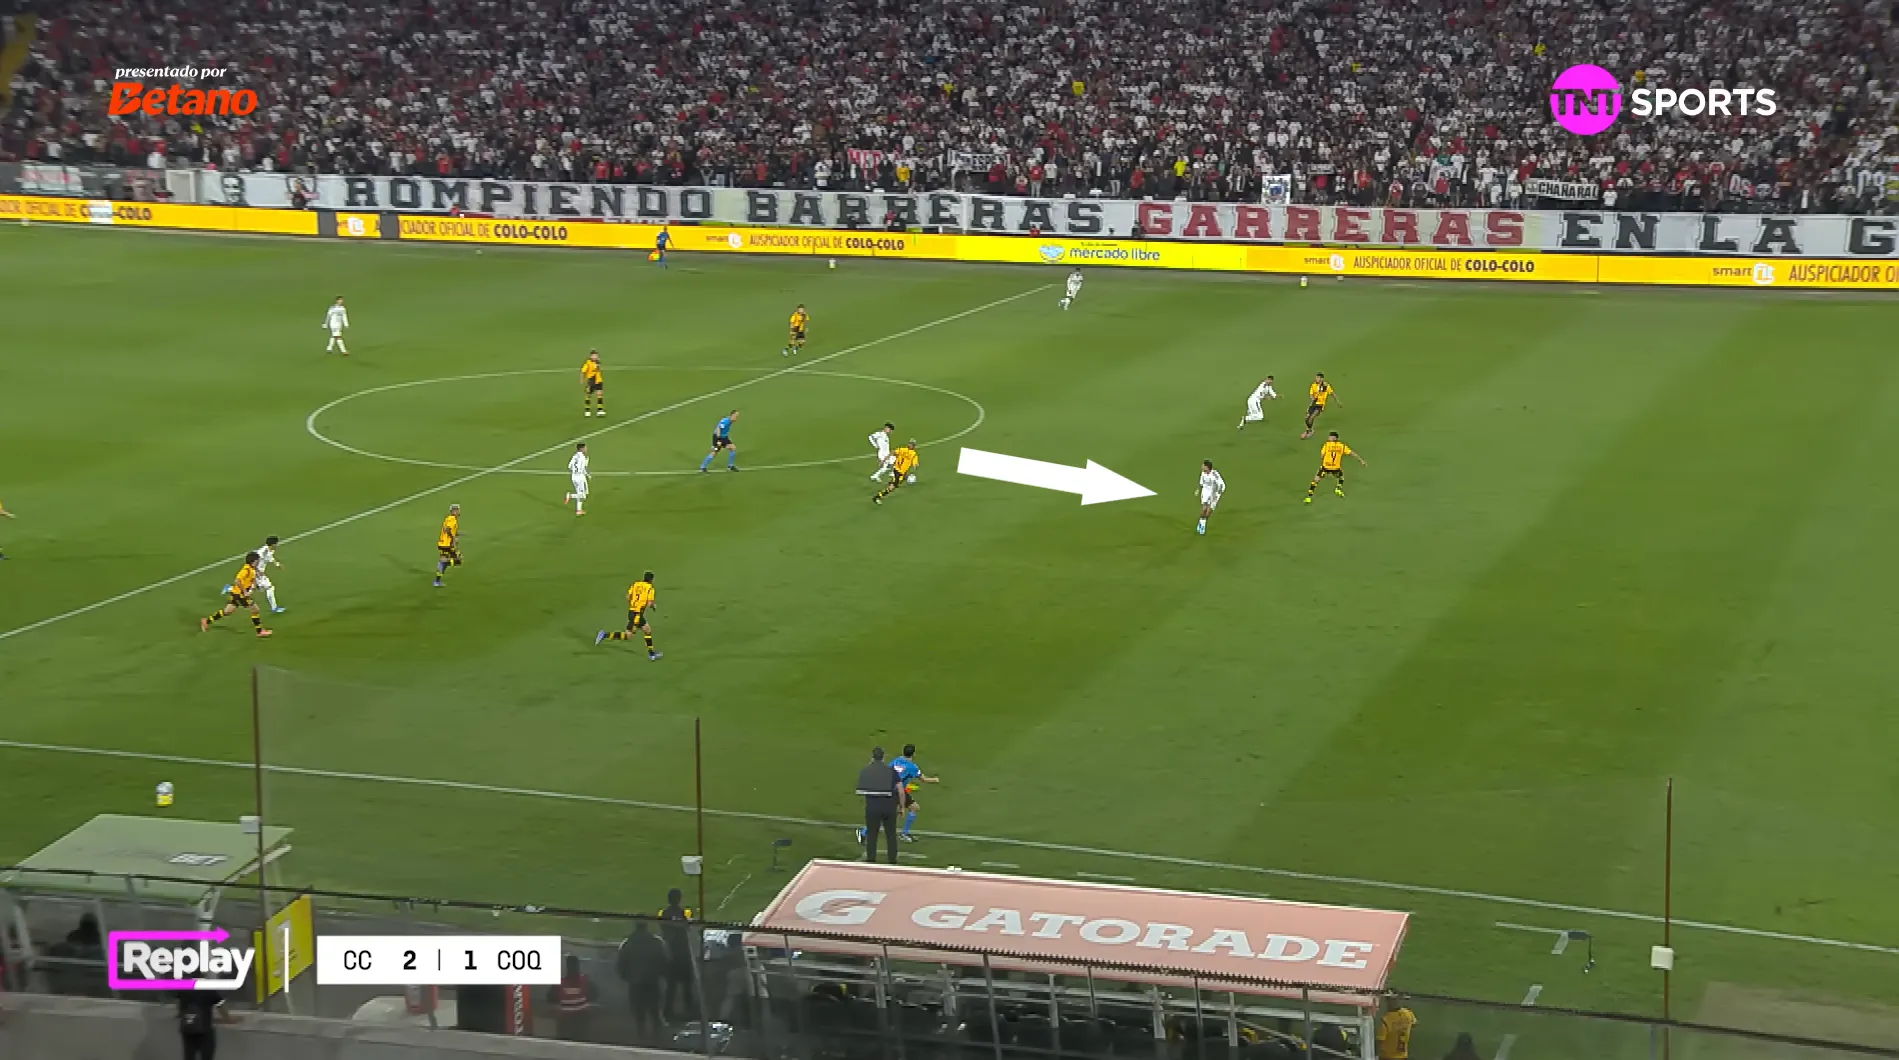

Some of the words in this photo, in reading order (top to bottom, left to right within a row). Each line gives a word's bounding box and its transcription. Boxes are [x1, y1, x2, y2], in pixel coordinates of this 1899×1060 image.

[346, 177, 713, 219] ROMPIENDO
[747, 192, 1104, 233] BARRERAS
[1138, 203, 1524, 244] GARRERAS
[1561, 212, 1657, 250] EN
[1701, 215, 1802, 255] LA
[1849, 217, 1896, 256] G
[478, 223, 491, 239] DE
[494, 223, 568, 241] COLO-COLO
[845, 237, 905, 251] COLO-COLO
[1069, 247, 1129, 260] mercado
[1131, 248, 1161, 261] libre
[1353, 257, 1412, 271] AUSPICIADOR
[1414, 258, 1448, 272] OFICIAL
[1450, 259, 1463, 272] DE
[1465, 259, 1535, 273] COLO-COLO
[1712, 266, 1753, 277] smart
[1788, 264, 1881, 283] AUSPICIADOR
[794, 889, 887, 925] G
[910, 903, 1375, 970] GATORADE
